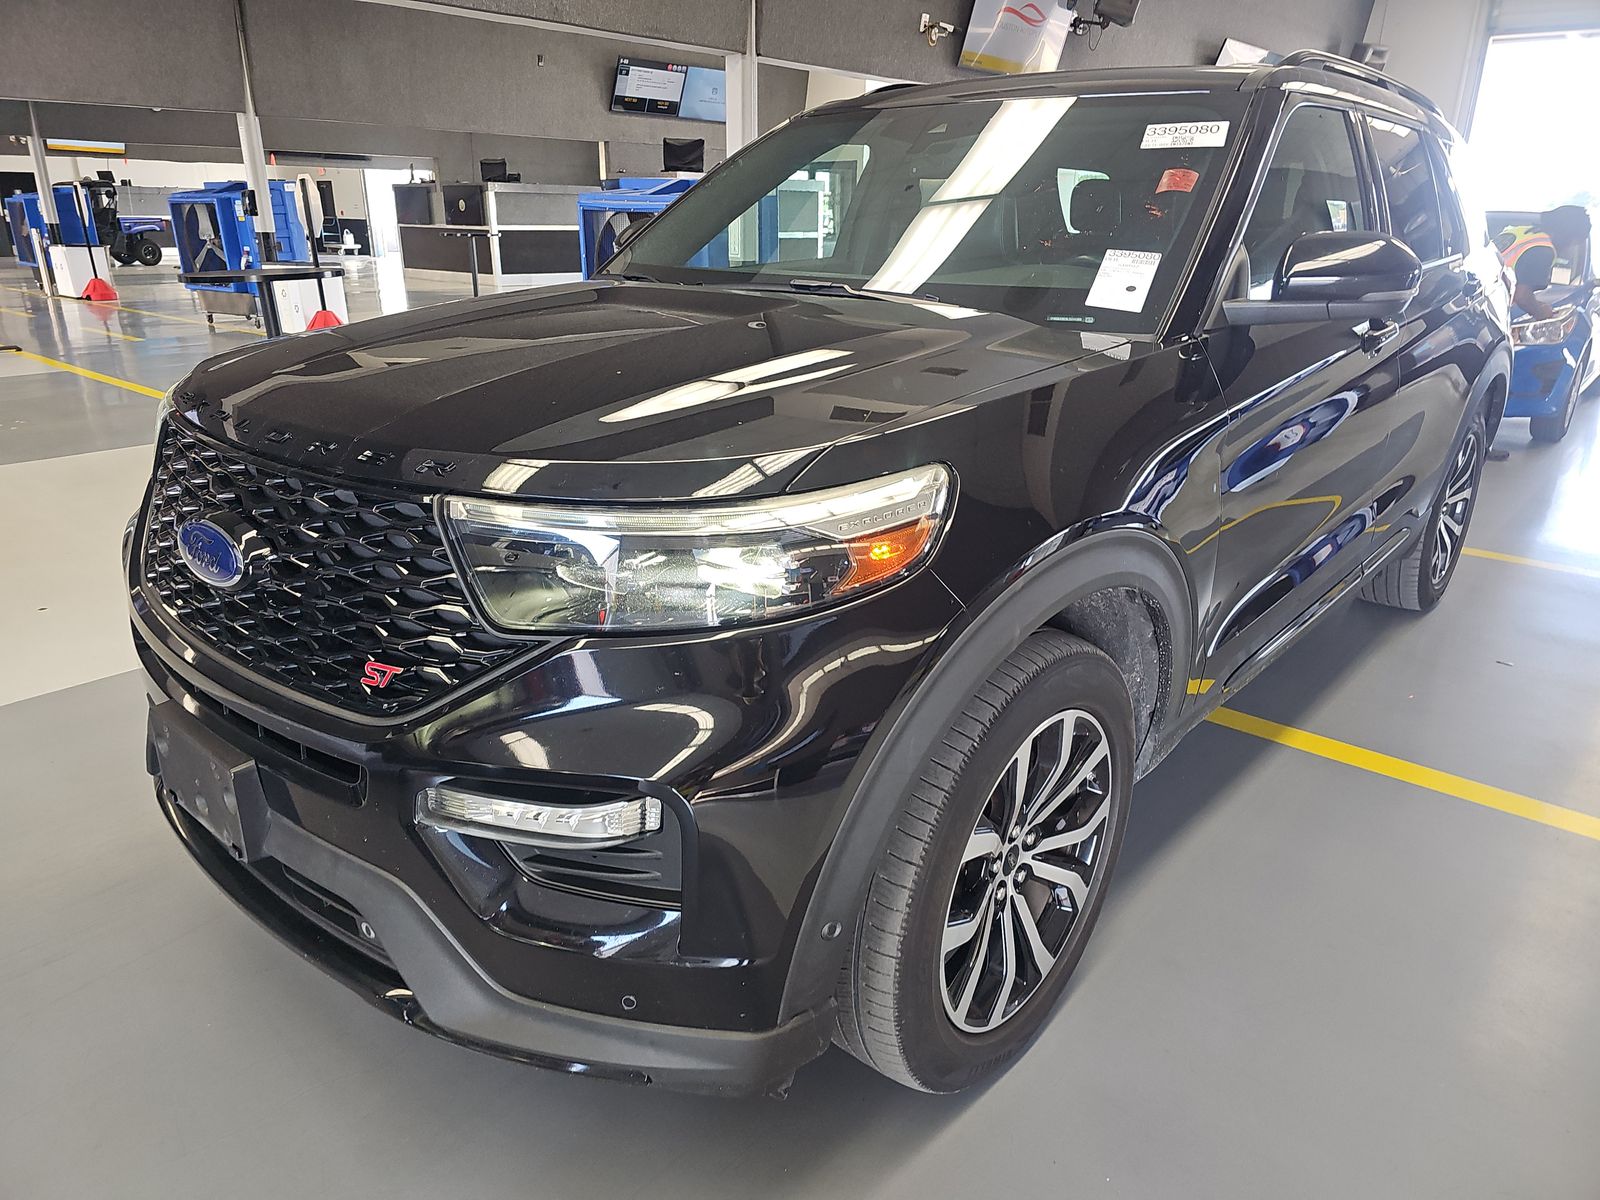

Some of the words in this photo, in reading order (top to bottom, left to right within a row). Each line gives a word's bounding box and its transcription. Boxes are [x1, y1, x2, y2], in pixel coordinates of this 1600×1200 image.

[1146, 124, 1220, 137] 3395080
[1108, 249, 1162, 261] 3395080
[838, 500, 927, 531] EXPLORER
[186, 529, 221, 574] Ford
[361, 661, 404, 688] ST
